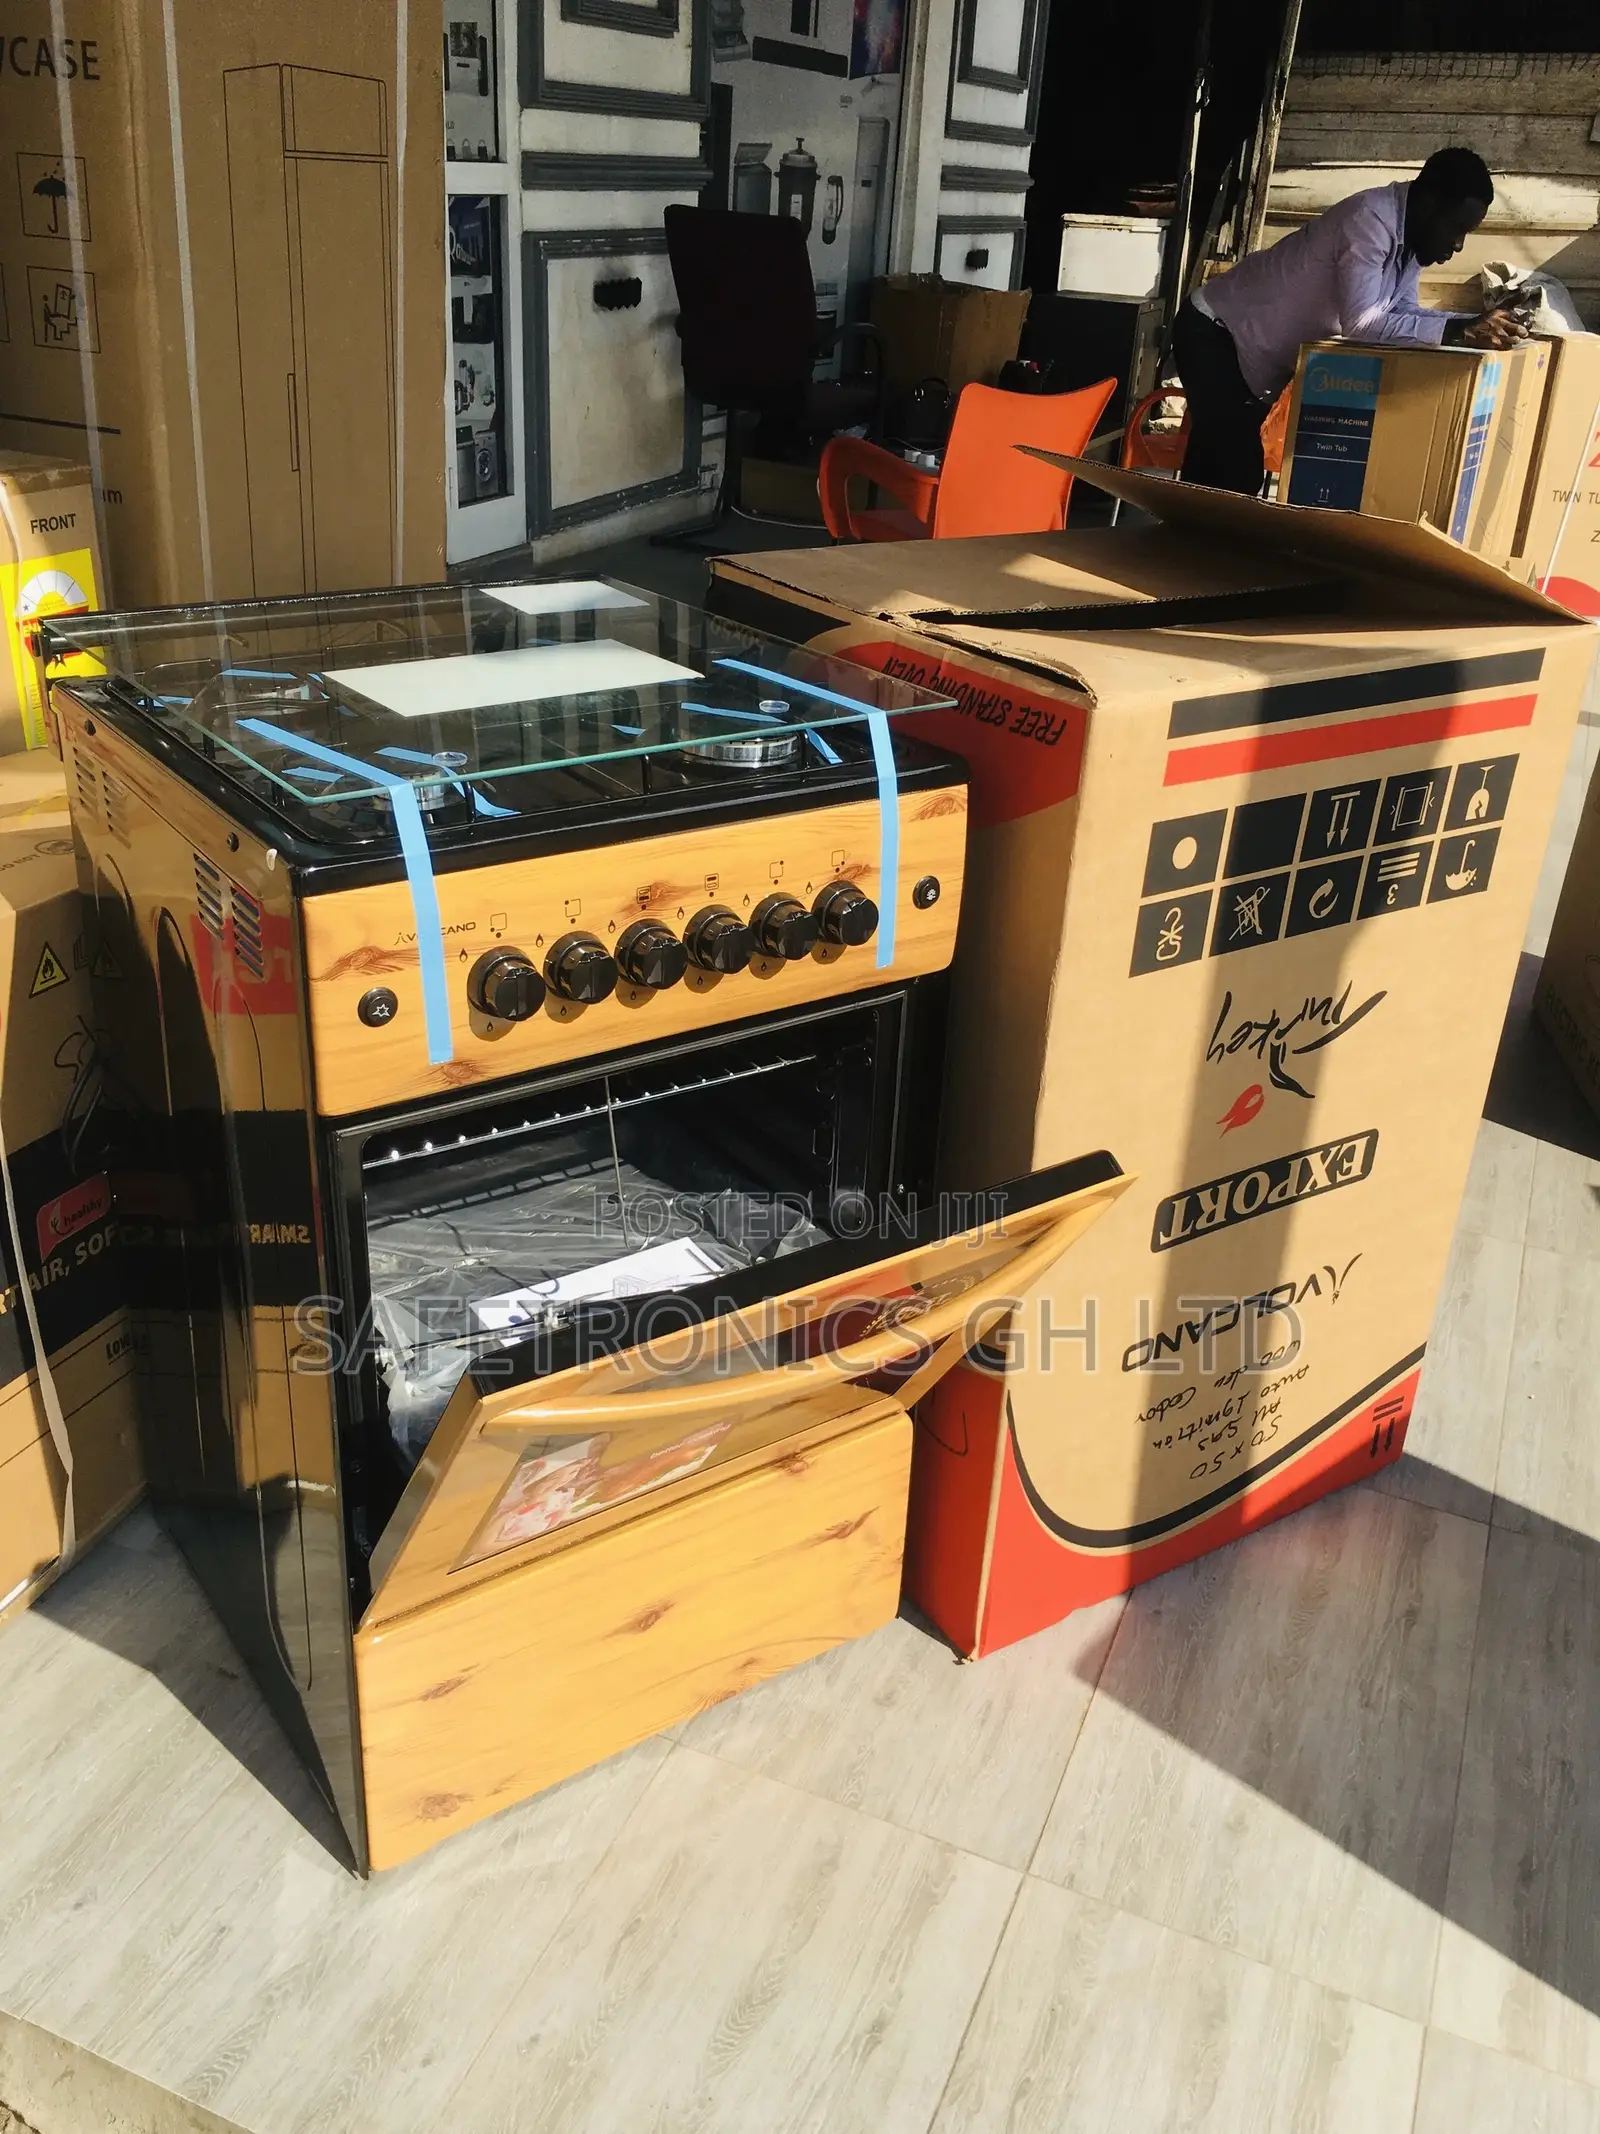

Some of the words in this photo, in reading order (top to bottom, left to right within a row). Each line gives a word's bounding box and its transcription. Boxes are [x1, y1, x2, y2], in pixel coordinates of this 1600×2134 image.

[0, 36, 101, 80] CASE
[1337, 417, 1369, 427] MACHINE
[1316, 442, 1333, 451] Twin
[1334, 444, 1348, 453] Tub
[1552, 490, 1582, 503] TWN
[30, 513, 77, 535] FRONT
[1008, 705, 1068, 746] FREE
[1205, 980, 1388, 1066] Turkey
[1159, 1135, 1371, 1245] EXPORT
[1121, 1273, 1322, 1374] VOLCANO
